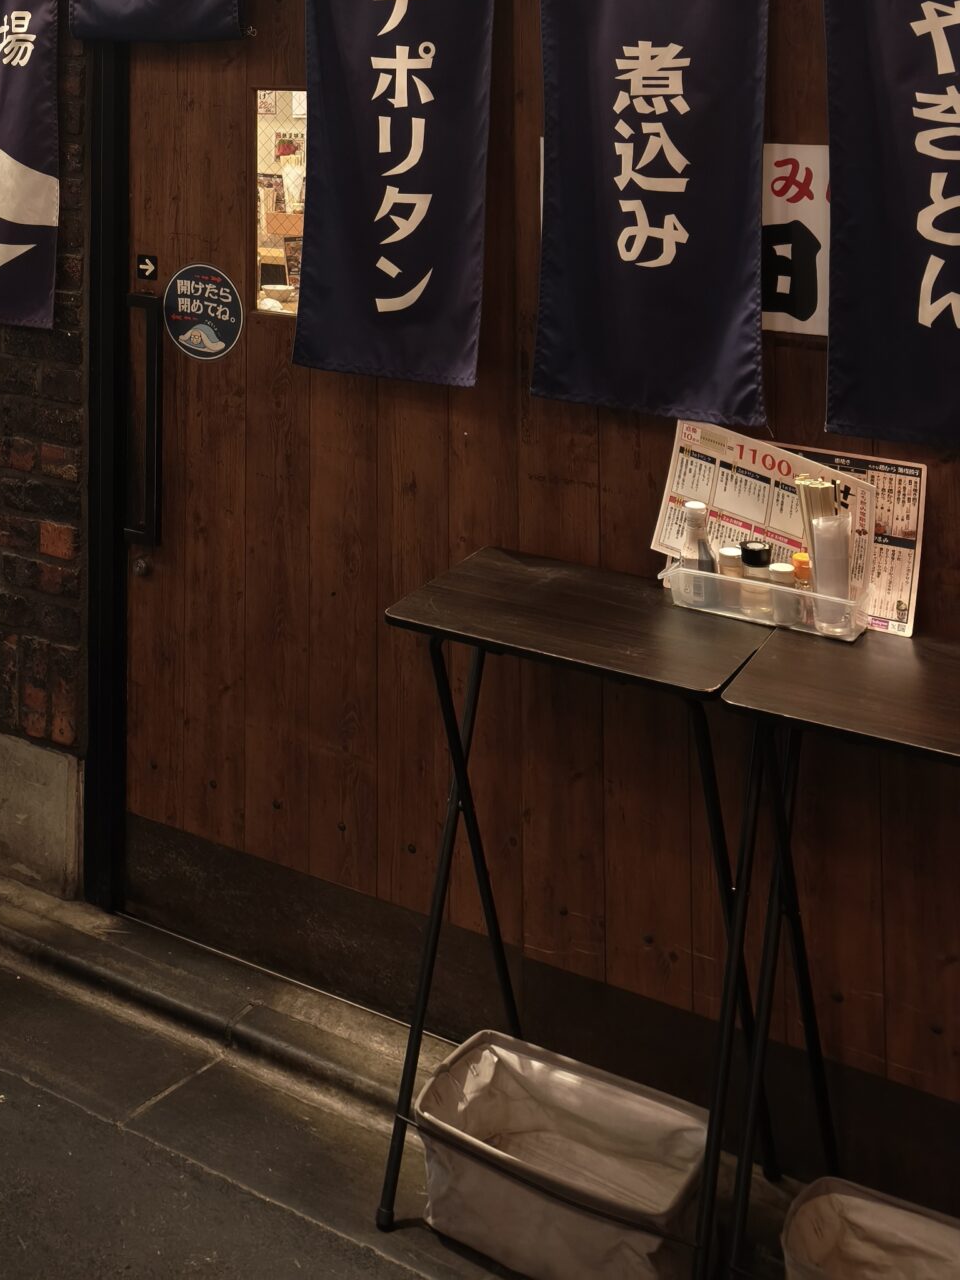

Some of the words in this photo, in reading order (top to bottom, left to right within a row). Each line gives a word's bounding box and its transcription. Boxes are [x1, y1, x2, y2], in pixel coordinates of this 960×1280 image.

[613, 40, 691, 267] 煮込み
[771, 158, 814, 203] み
[176, 279, 232, 302] 開けたら
